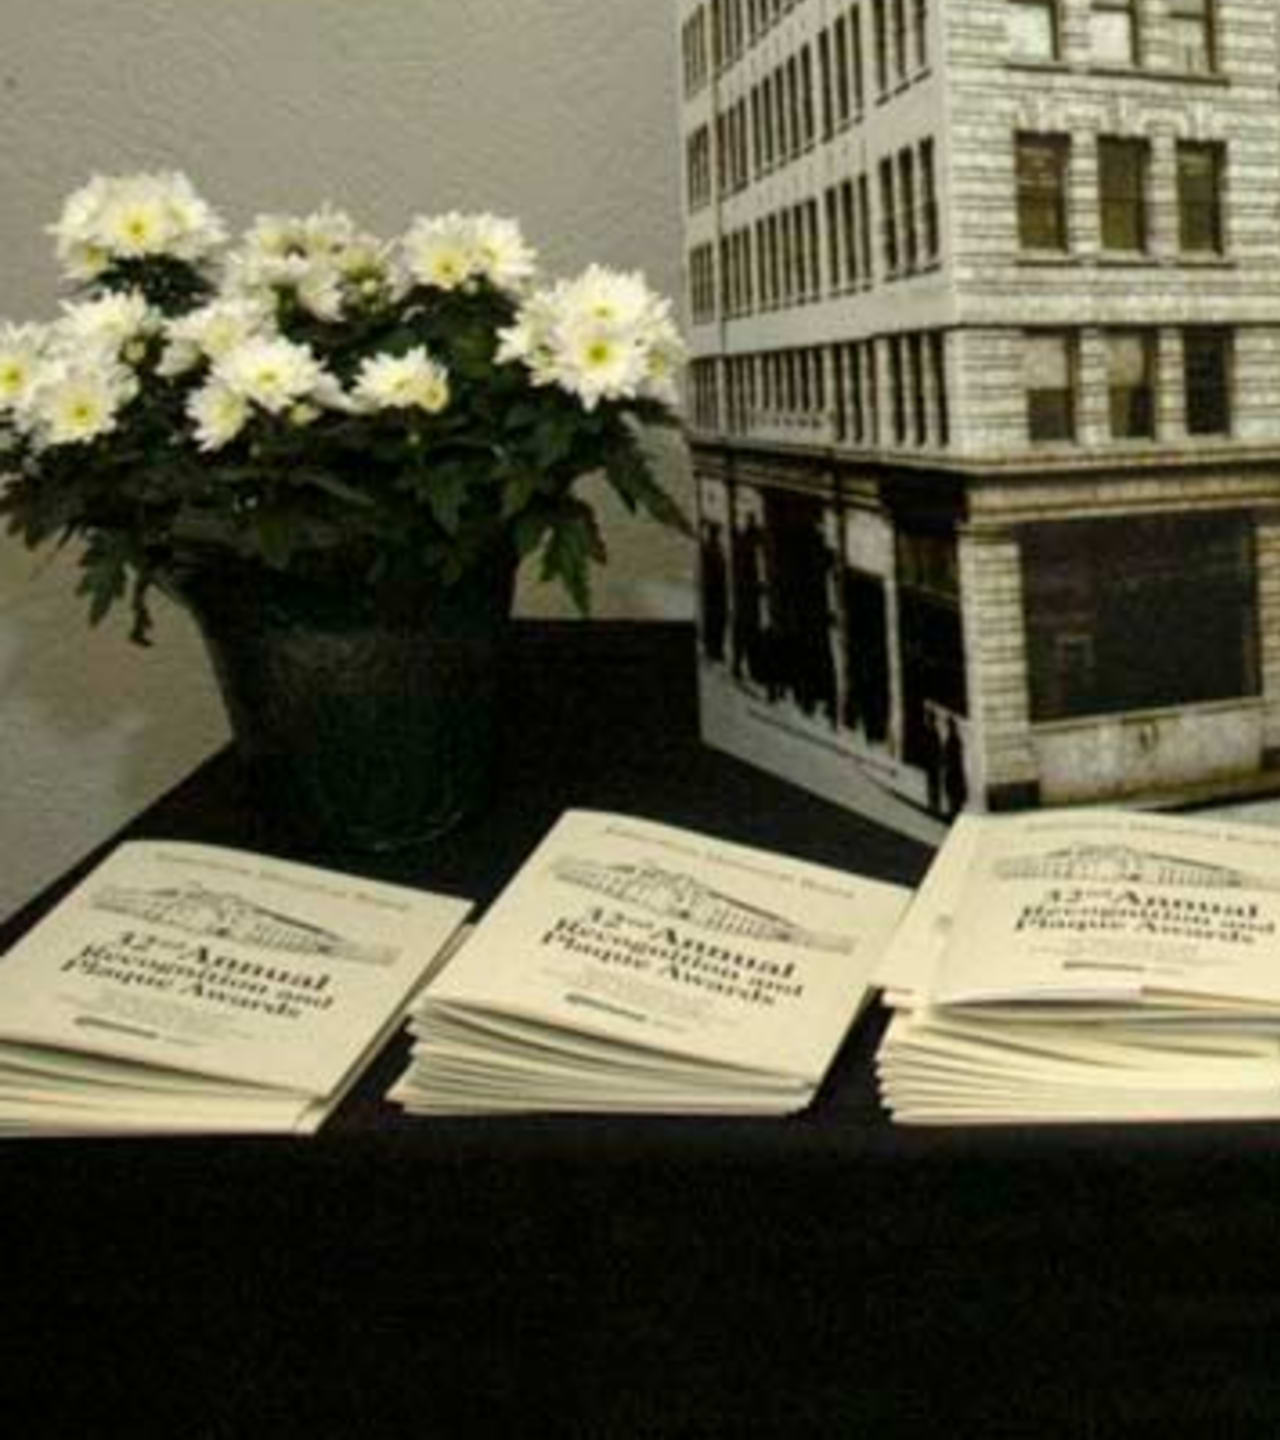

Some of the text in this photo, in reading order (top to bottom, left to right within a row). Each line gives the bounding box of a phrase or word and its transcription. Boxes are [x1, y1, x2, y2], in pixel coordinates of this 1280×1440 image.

[1112, 889, 1259, 919] Annual
[80, 943, 335, 1011] Recognition and
[175, 945, 332, 992] Annual
[554, 917, 804, 998] Recognition and
[649, 926, 796, 980] Annual
